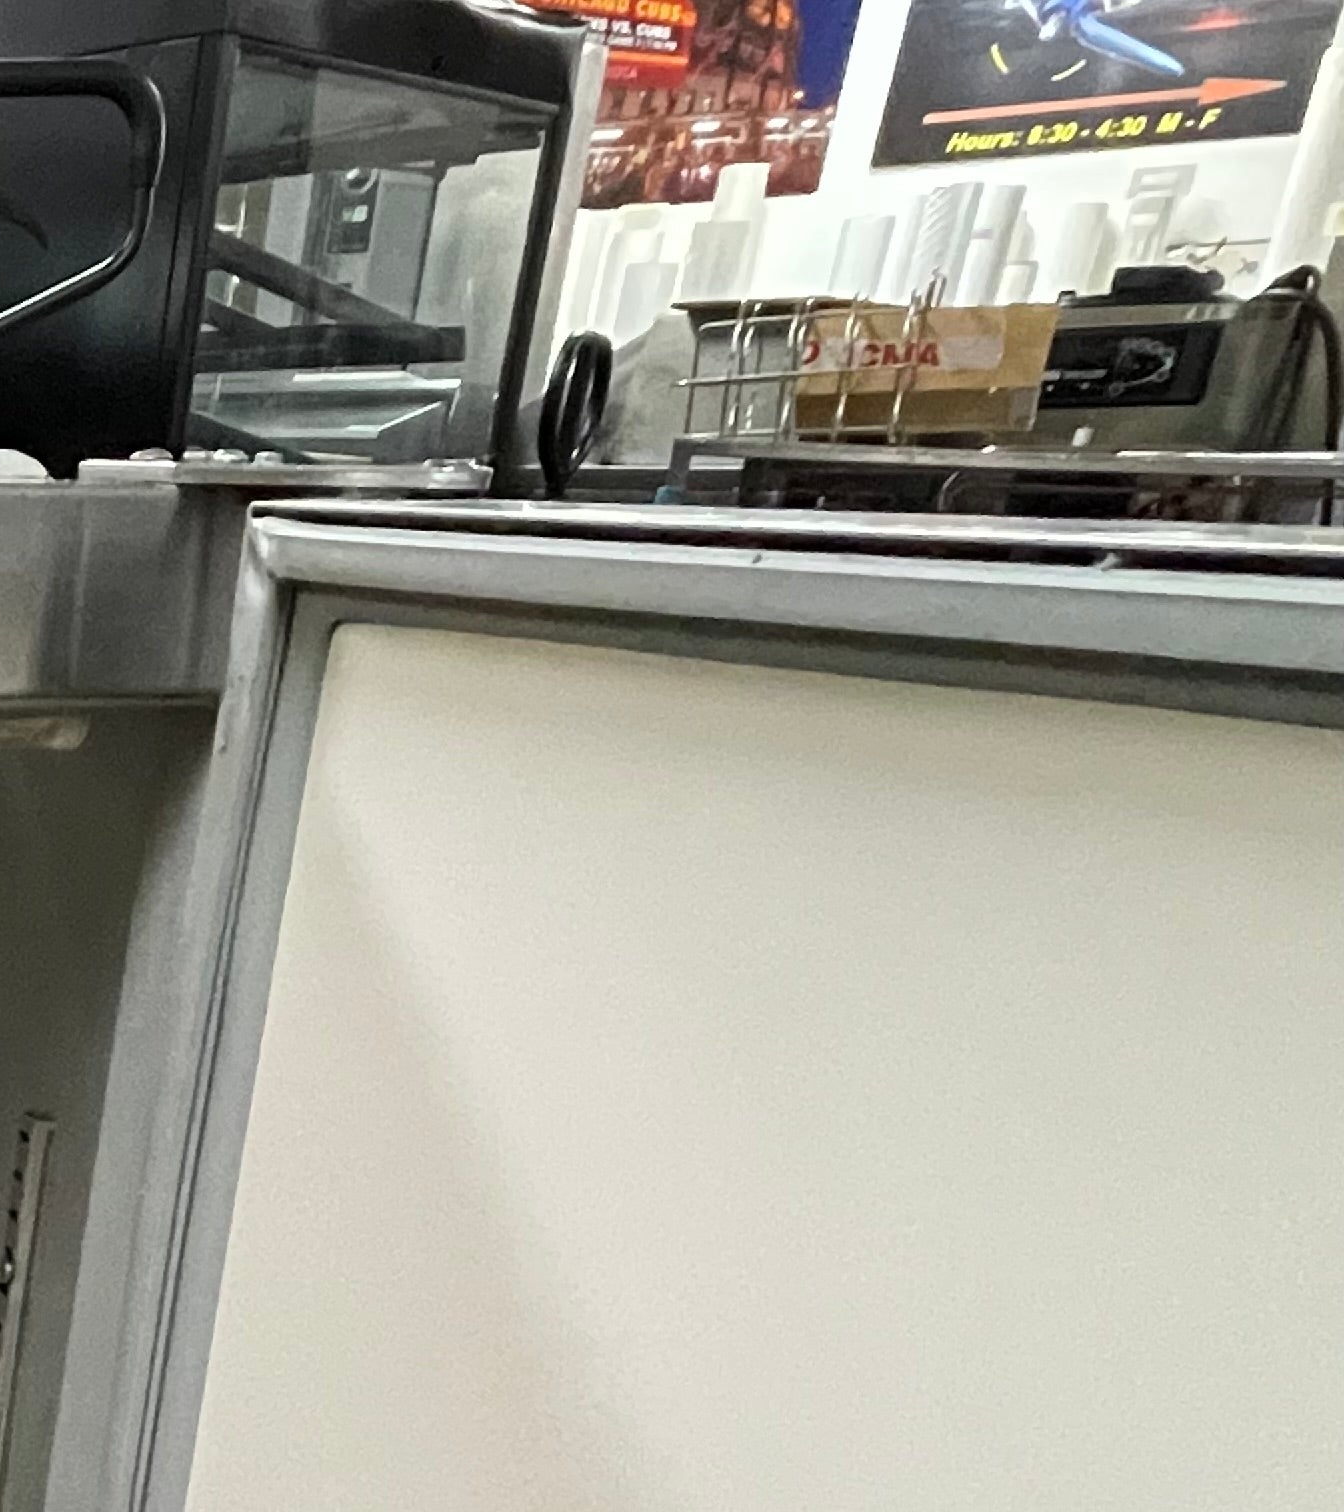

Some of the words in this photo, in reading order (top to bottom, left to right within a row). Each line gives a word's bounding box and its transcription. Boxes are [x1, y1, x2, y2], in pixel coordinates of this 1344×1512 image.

[945, 130, 1022, 154] Hours:
[1095, 115, 1148, 138] 4:30
[1157, 111, 1183, 133] M
[1199, 107, 1222, 130] F
